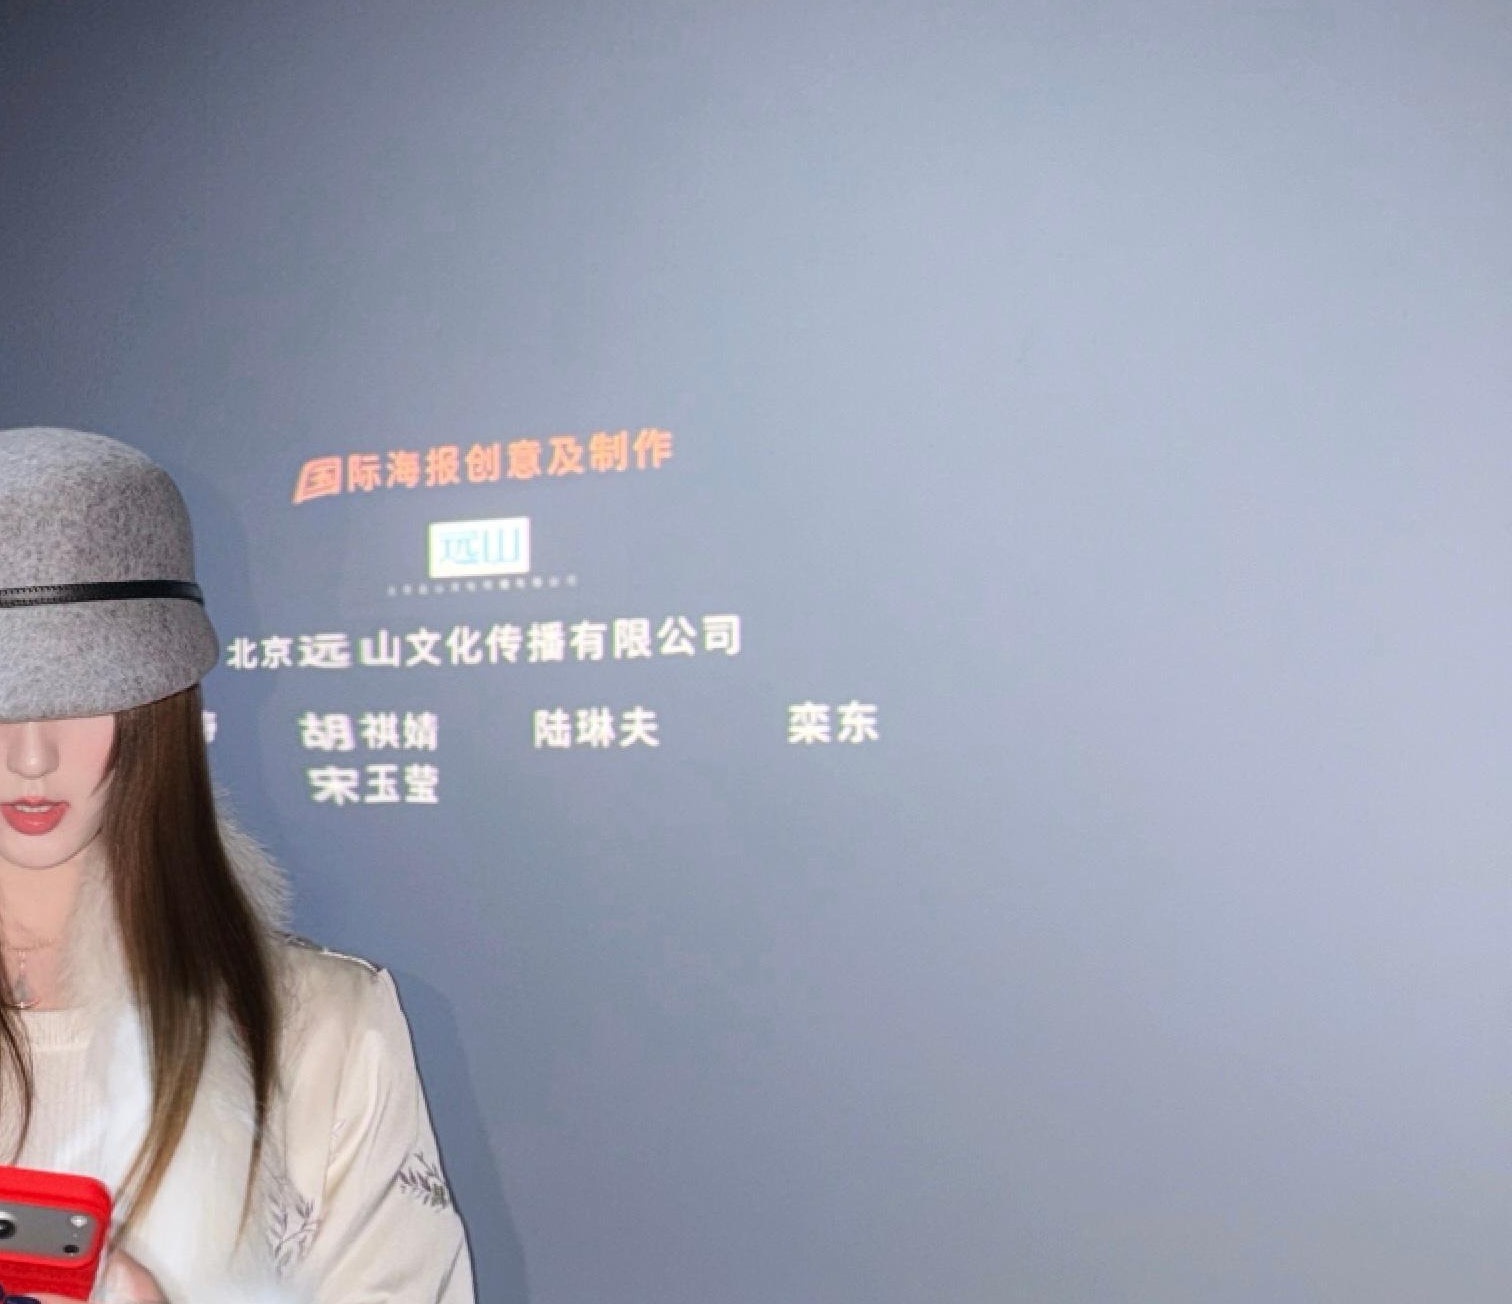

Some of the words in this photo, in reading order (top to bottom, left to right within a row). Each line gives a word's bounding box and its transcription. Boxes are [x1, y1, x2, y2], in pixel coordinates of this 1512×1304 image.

[293, 428, 673, 503] 国际海报创意及制作
[439, 528, 521, 565] 远山
[227, 614, 742, 670] 北京远山文化传播有限公司
[299, 711, 439, 751] 胡祺婧
[534, 706, 660, 748] 陆琳夫
[789, 701, 879, 743] 栾东
[307, 763, 439, 805] 宋玉莹
